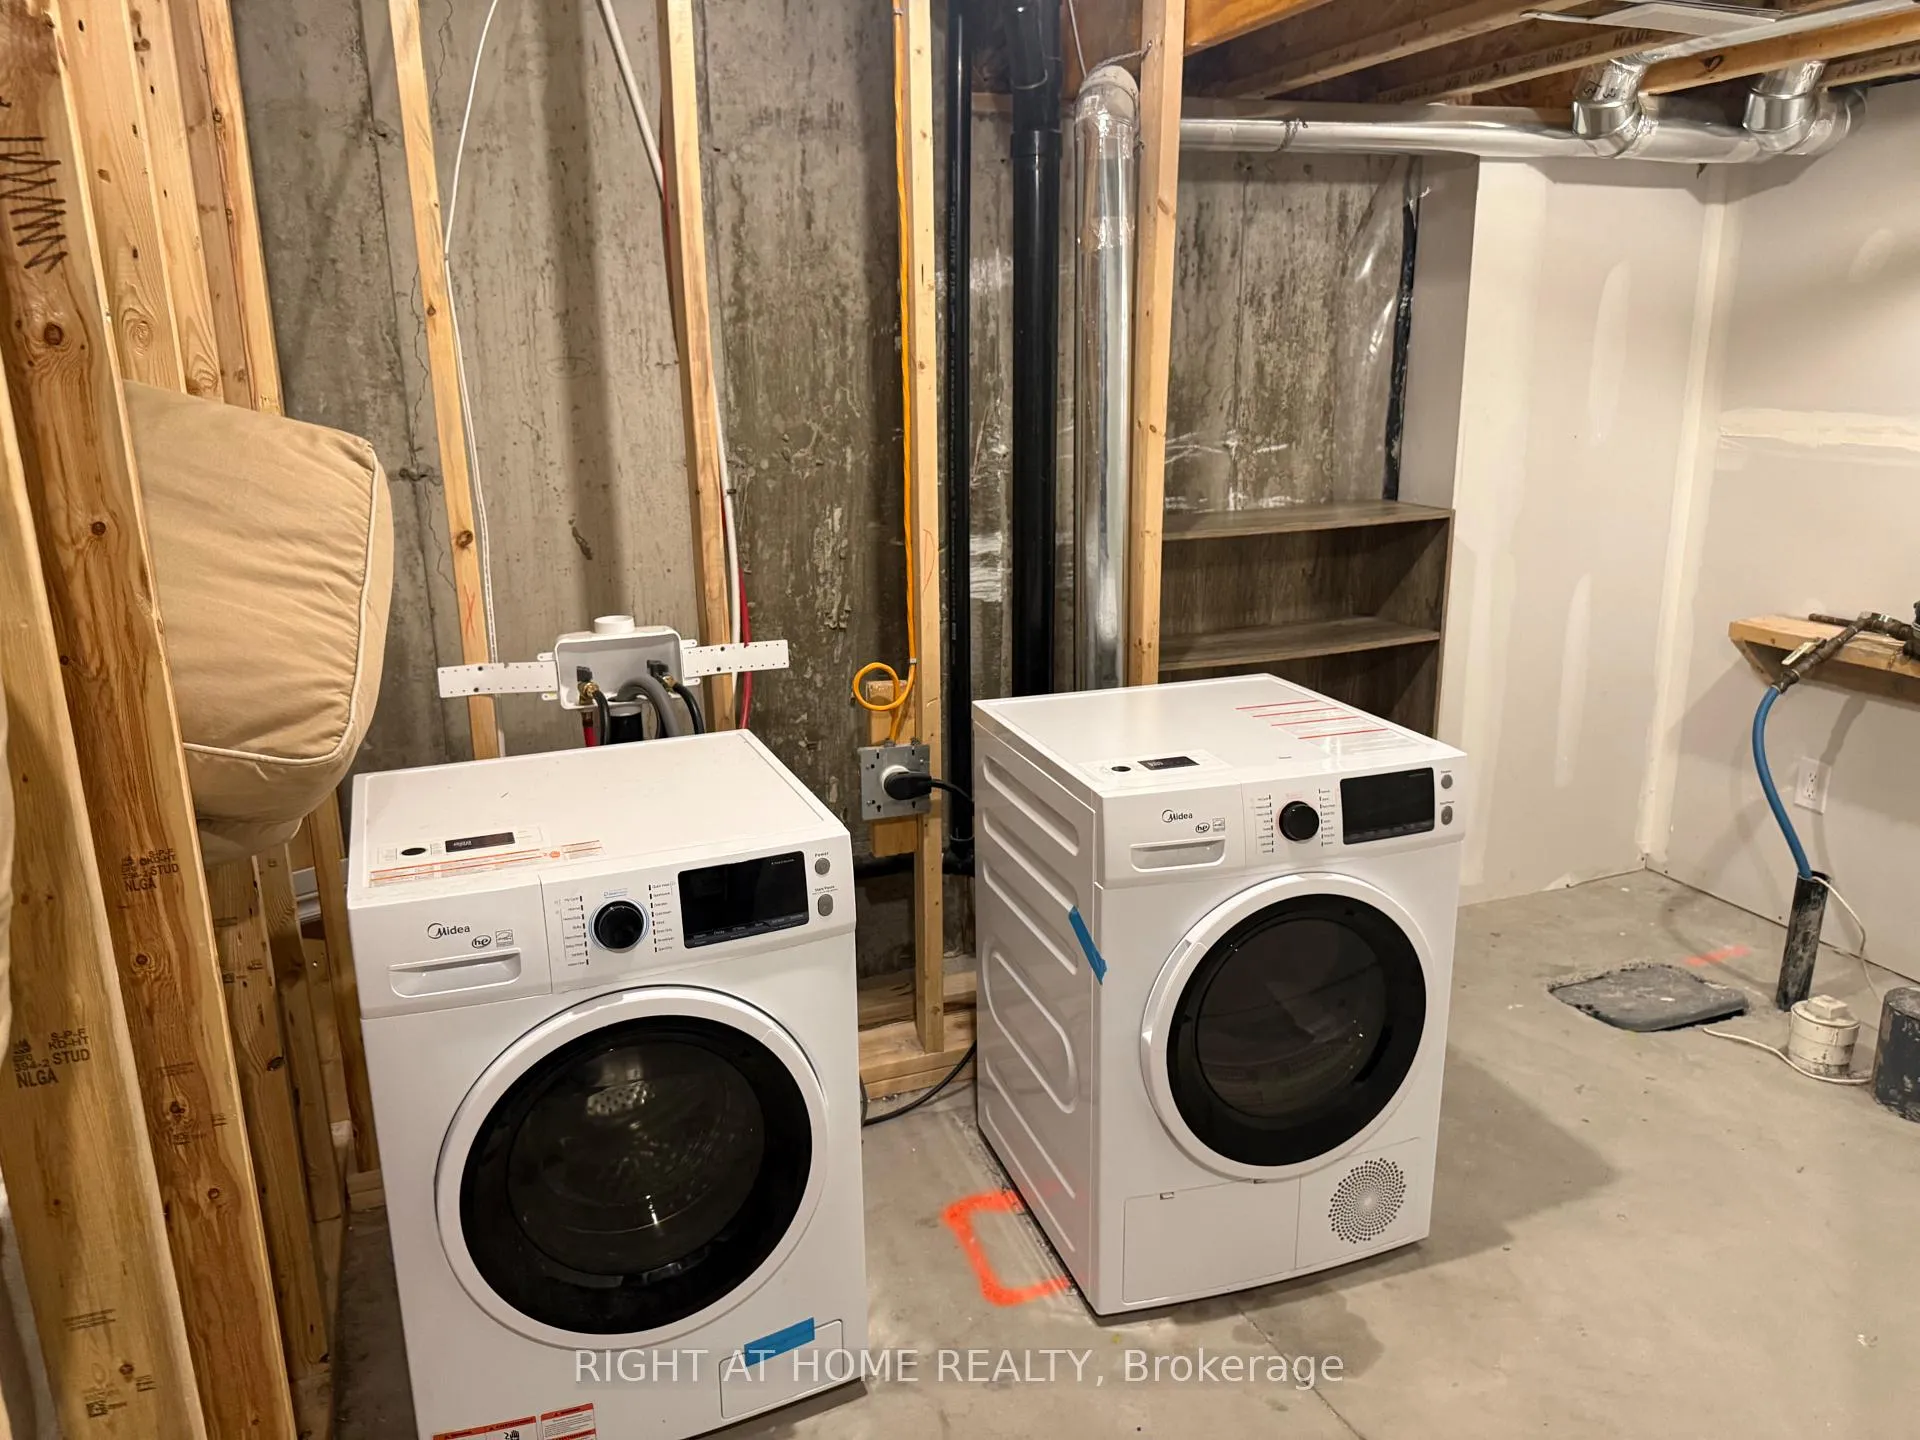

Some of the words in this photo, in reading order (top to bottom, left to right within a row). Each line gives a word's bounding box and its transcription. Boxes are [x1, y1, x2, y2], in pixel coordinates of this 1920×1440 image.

[1162, 809, 1193, 823] Midea
[150, 862, 179, 876] STUD
[125, 876, 157, 892] NLGA
[427, 922, 470, 939] Midea
[48, 1035, 89, 1050] KD-HT
[52, 1048, 91, 1066] STUD
[16, 1067, 59, 1089] NLGA
